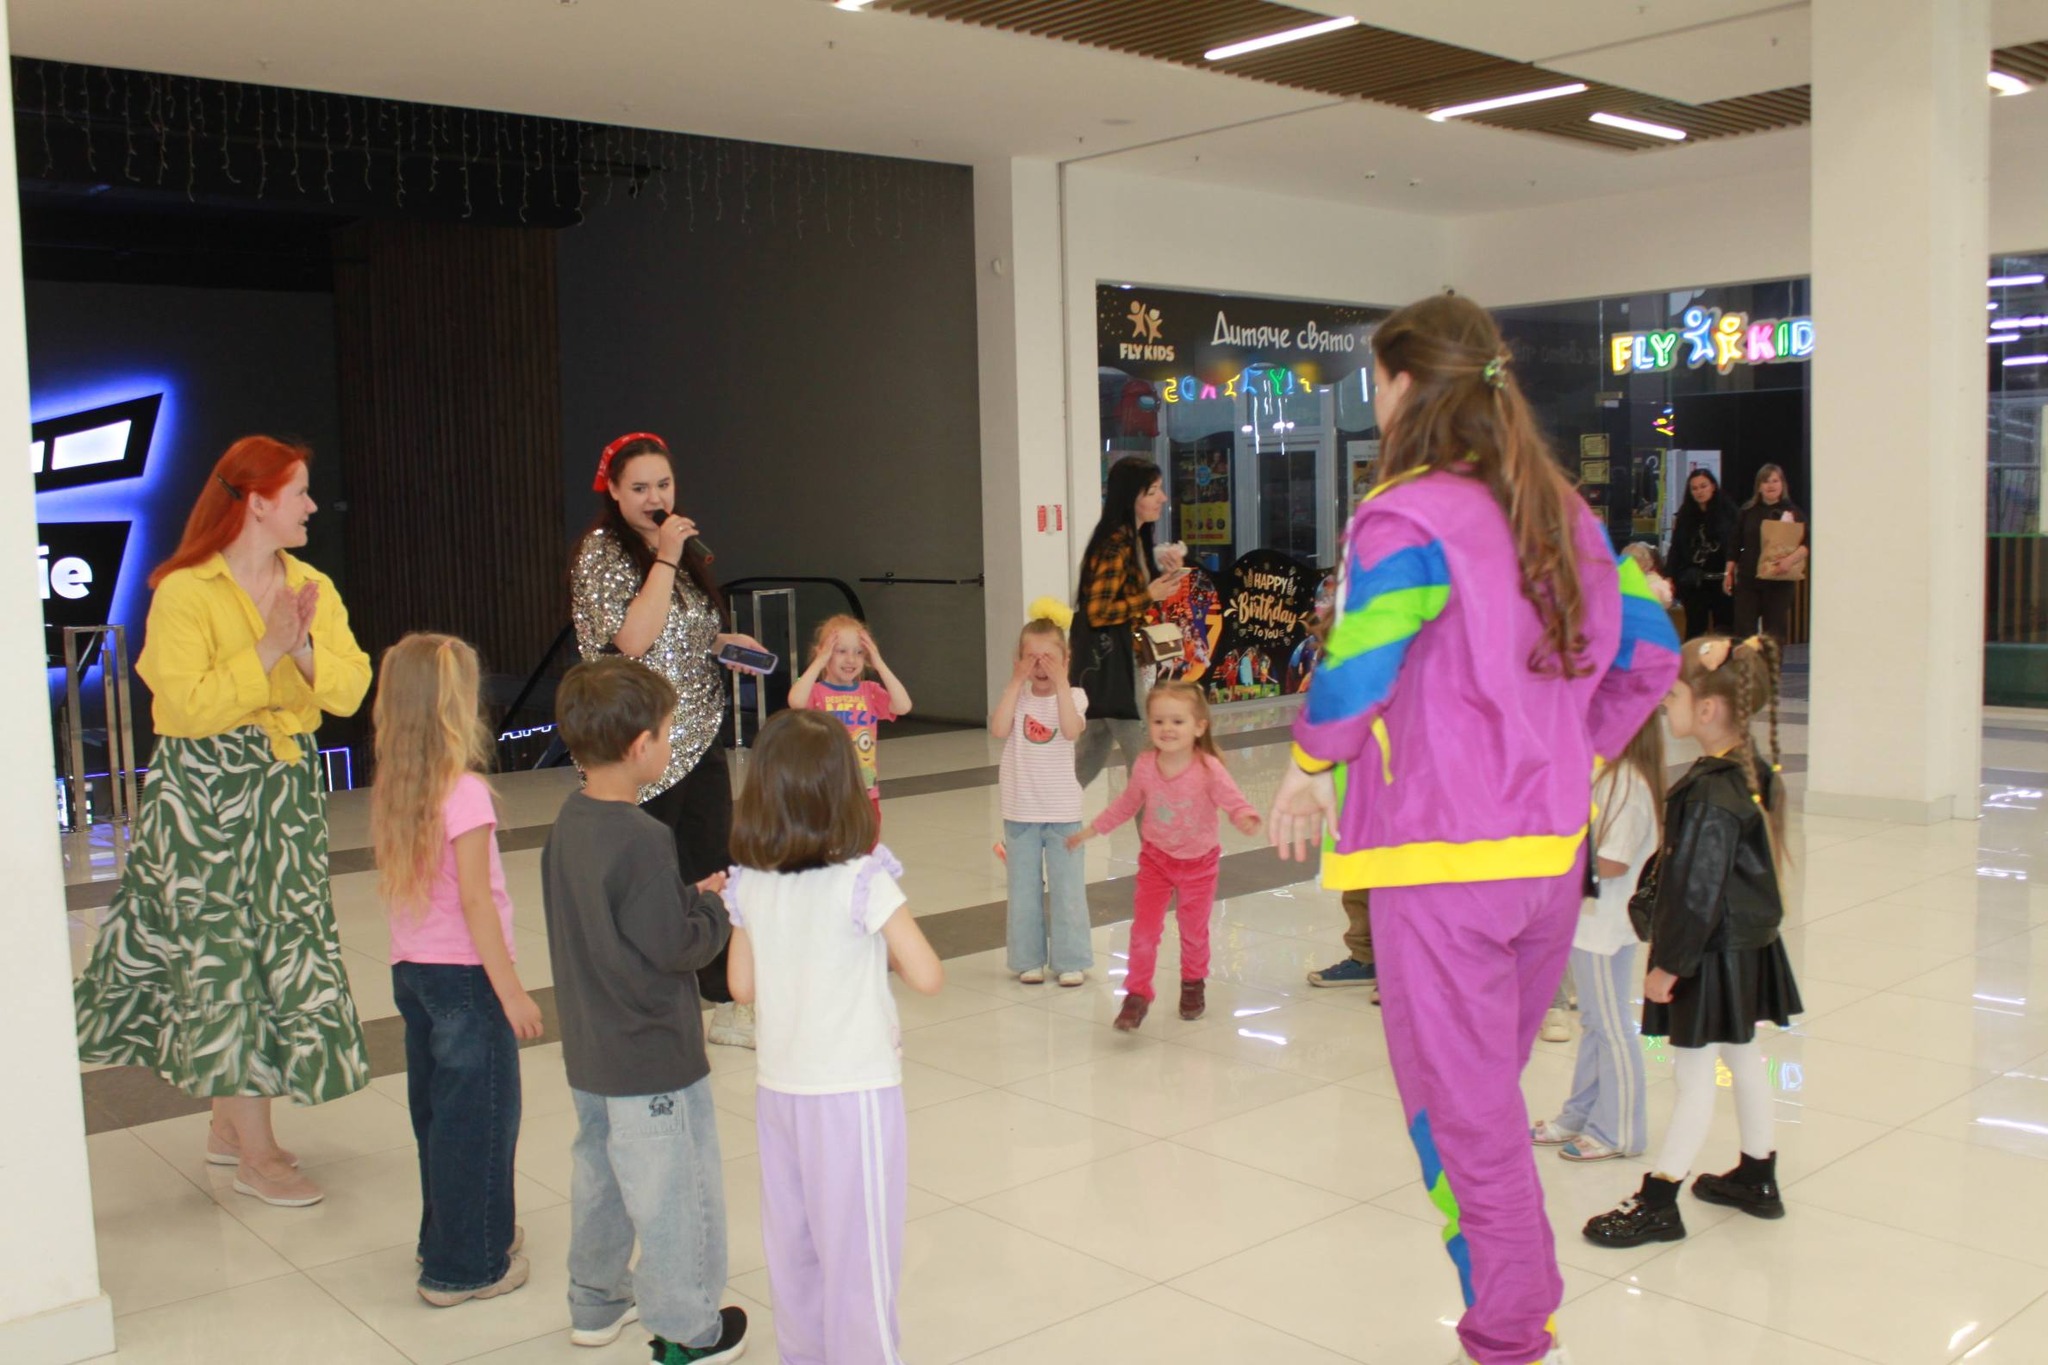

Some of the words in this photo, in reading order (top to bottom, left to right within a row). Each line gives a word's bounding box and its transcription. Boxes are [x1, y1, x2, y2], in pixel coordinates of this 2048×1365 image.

[1119, 342, 1143, 360] FLY
[1144, 344, 1175, 362] KIDS
[1211, 310, 1291, 349] Дитяче
[1297, 320, 1354, 353] свято
[1611, 333, 1677, 373] FLY
[1747, 320, 1815, 361] KID
[37, 544, 93, 600] ie
[1254, 572, 1288, 595] HAPPY
[1238, 591, 1297, 633] Birthday
